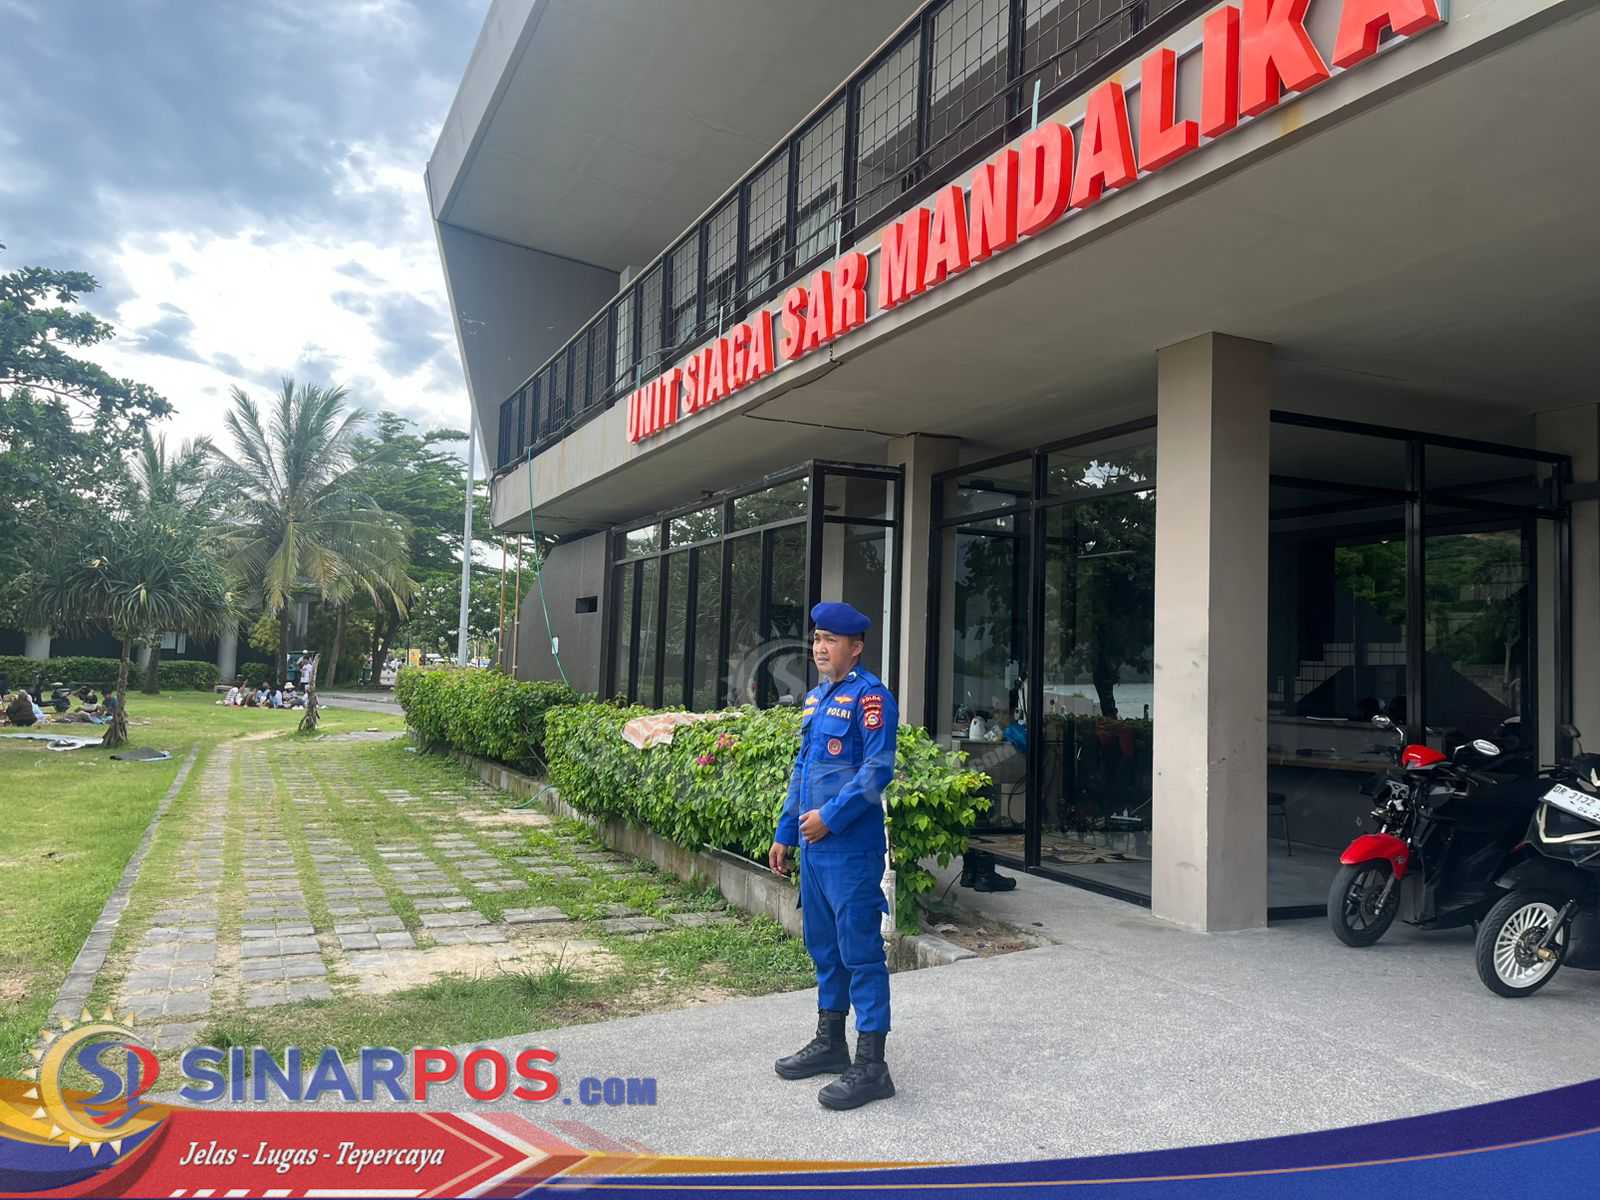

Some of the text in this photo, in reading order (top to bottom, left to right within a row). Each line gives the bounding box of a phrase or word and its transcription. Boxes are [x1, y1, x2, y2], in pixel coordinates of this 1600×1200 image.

[627, 368, 681, 444] UNIT
[681, 310, 775, 414] SIAGA
[779, 252, 868, 361] SAR
[826, 707, 851, 720] POLRI
